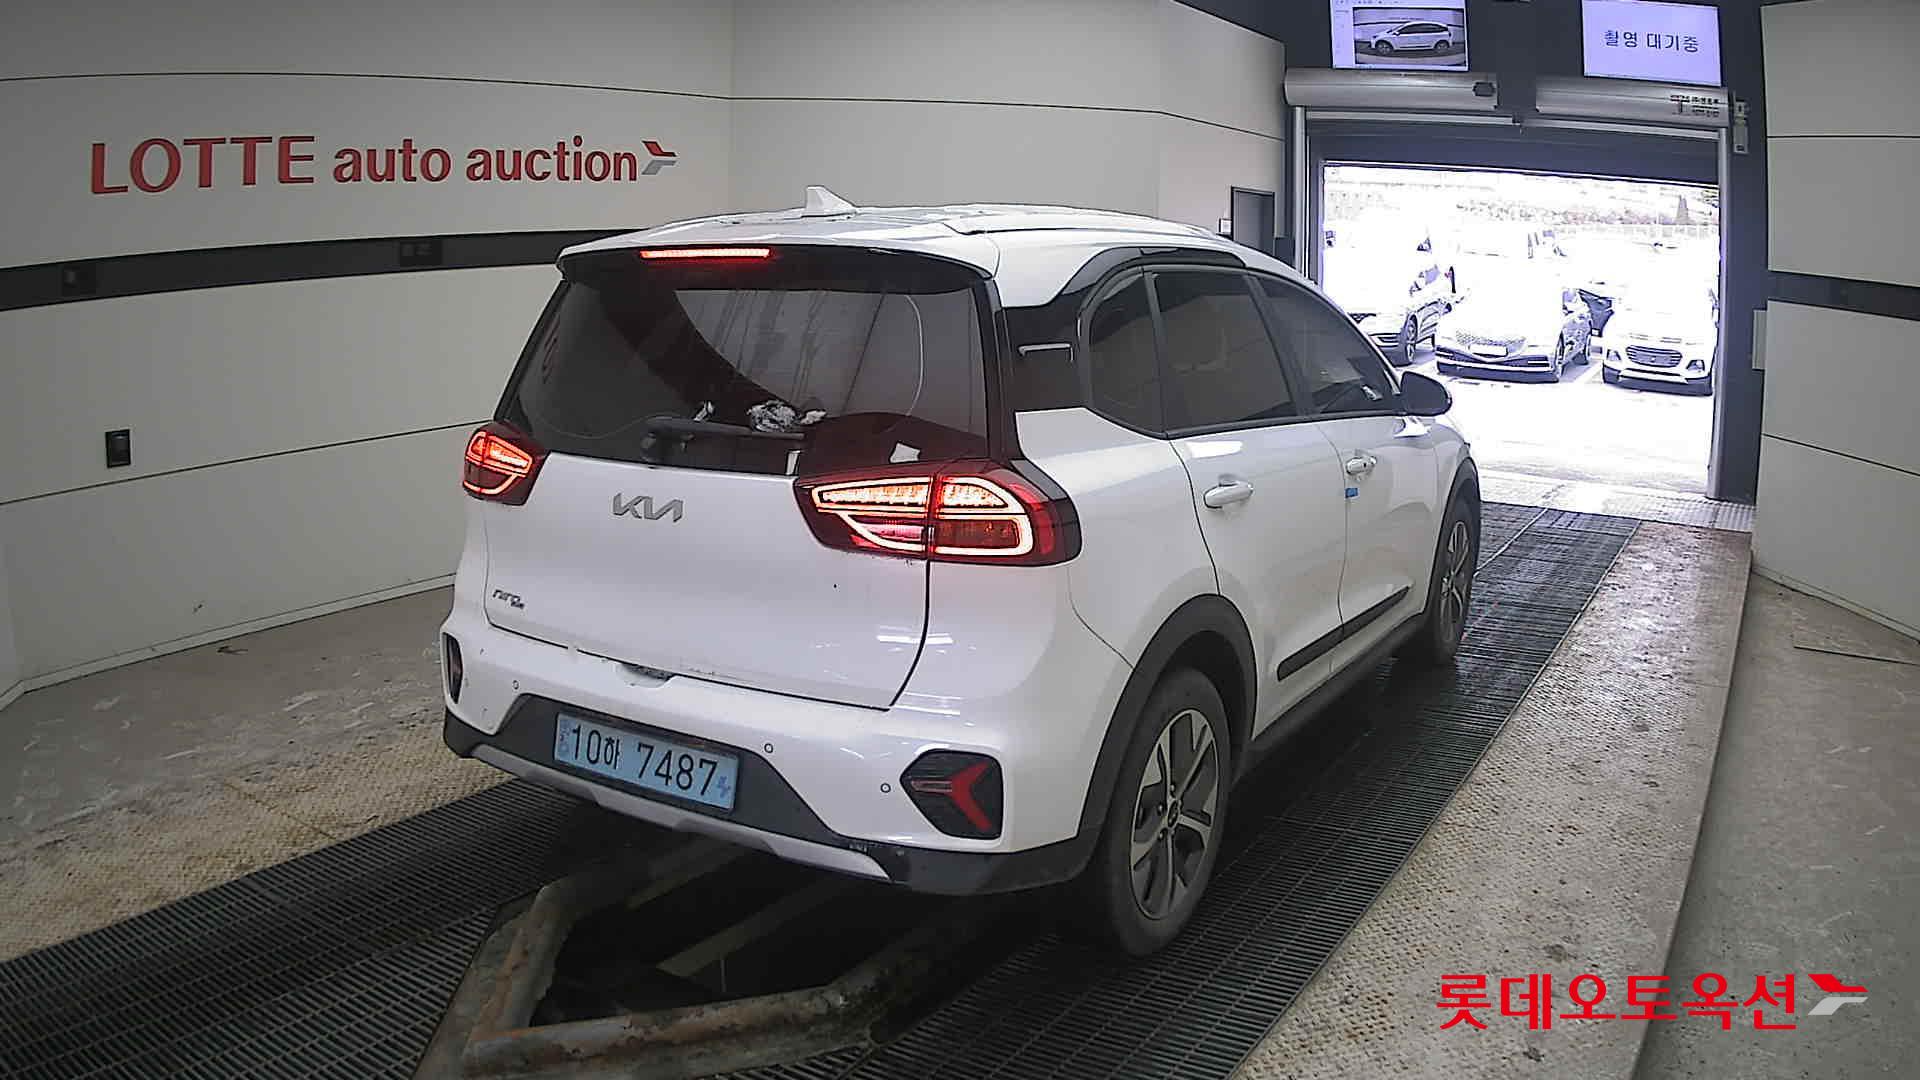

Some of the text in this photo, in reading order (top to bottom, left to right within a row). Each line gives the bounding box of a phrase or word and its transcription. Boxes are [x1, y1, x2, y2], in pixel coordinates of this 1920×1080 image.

[1646, 32, 1699, 53] 대기중
[92, 135, 638, 193] LOTTE auto auction
[572, 723, 620, 770] 10하
[636, 741, 718, 796] 7487
